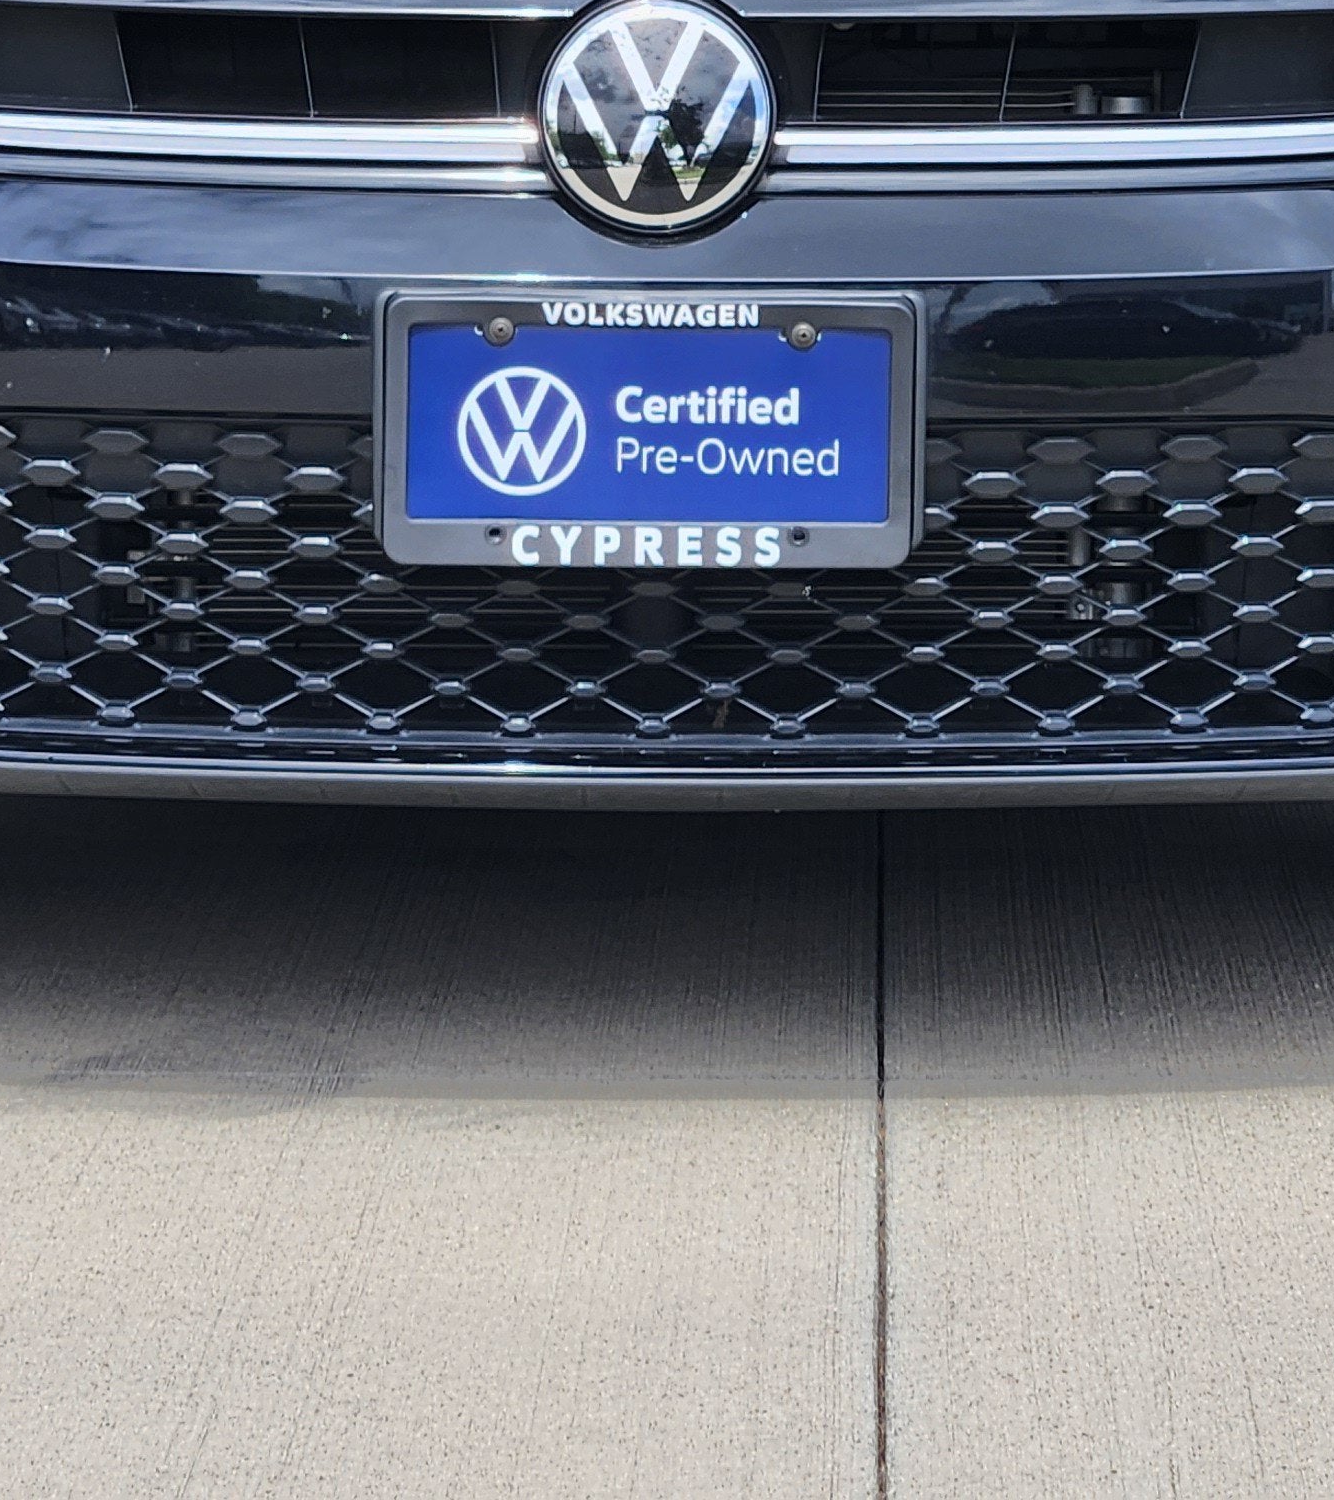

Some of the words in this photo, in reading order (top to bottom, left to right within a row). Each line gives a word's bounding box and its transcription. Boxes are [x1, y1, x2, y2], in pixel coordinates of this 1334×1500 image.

[542, 302, 760, 328] VOLKSWAGEN
[615, 386, 800, 426] Certified
[457, 366, 587, 497] VW
[615, 437, 841, 477] Pre-Owned
[510, 525, 781, 567] CYPRESS
